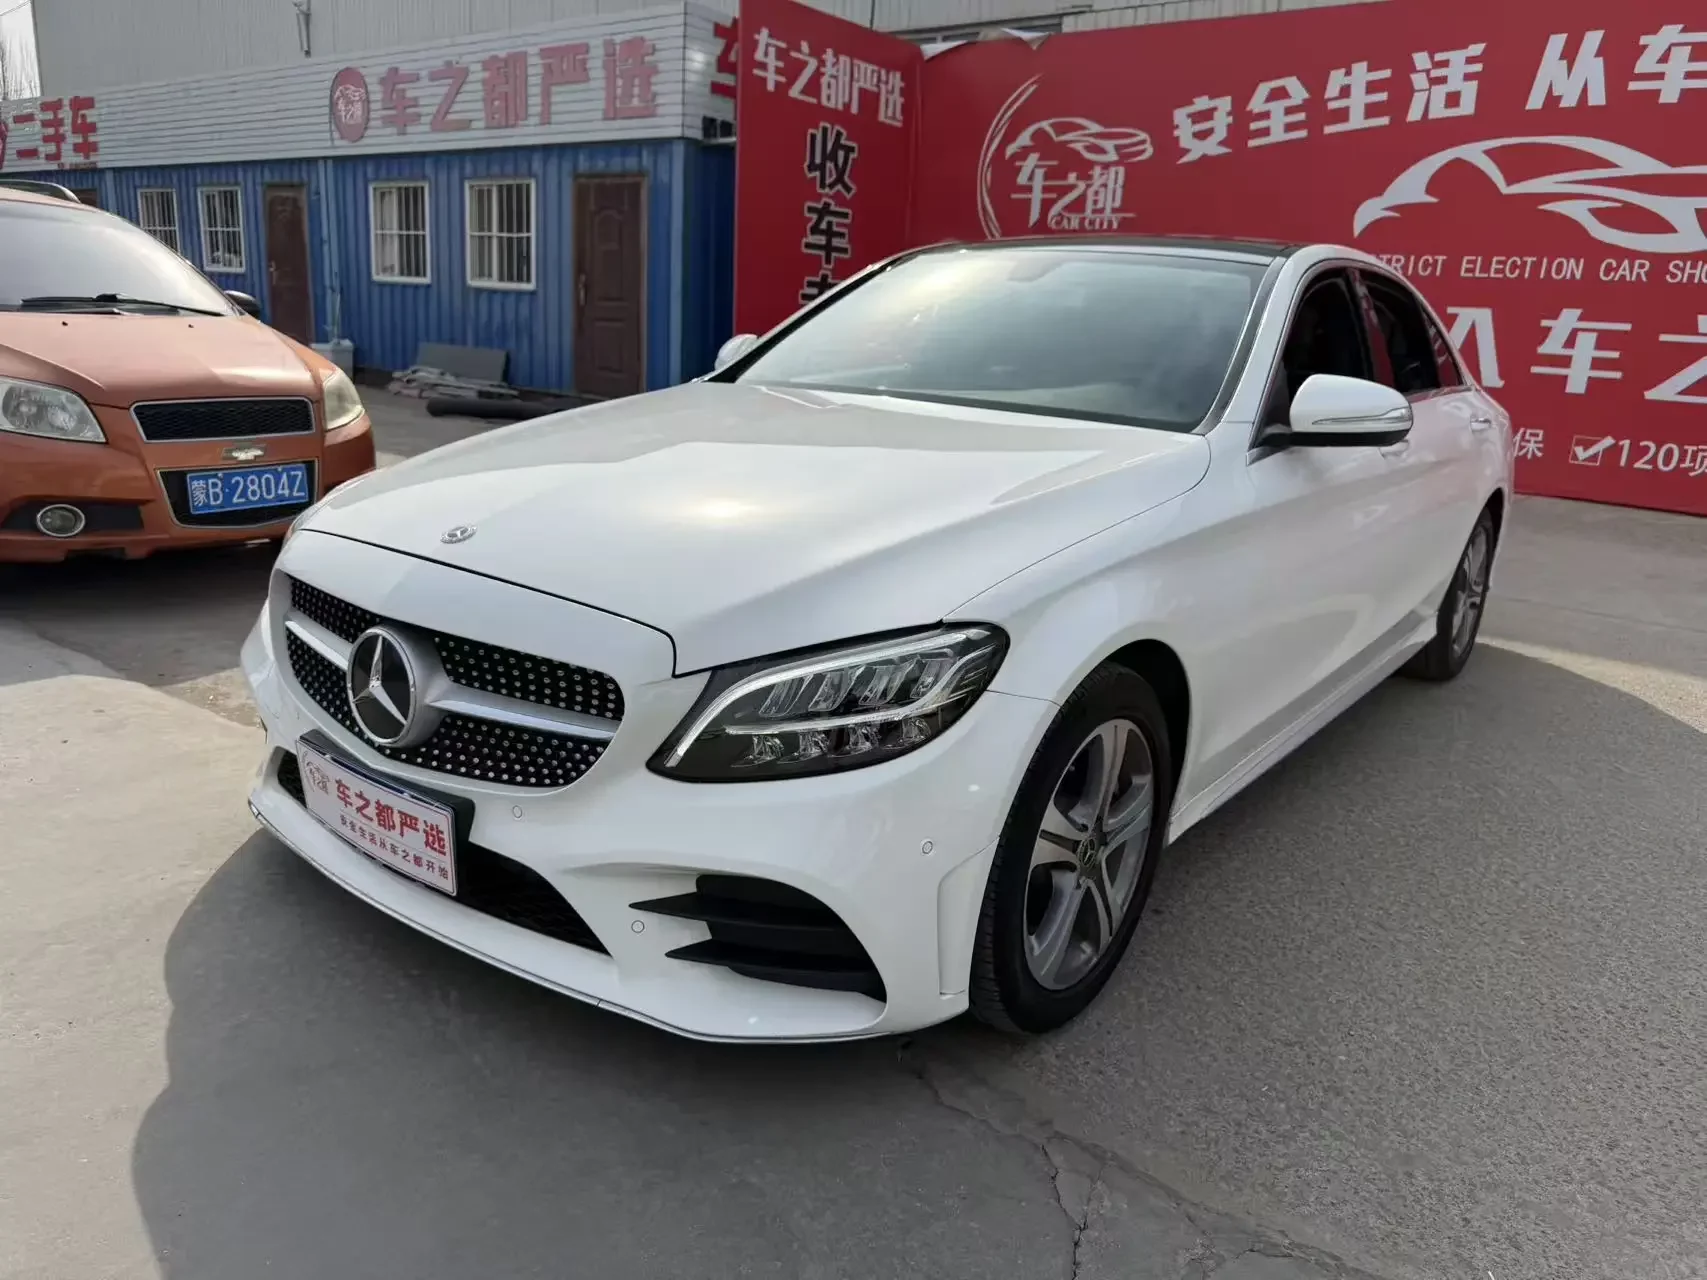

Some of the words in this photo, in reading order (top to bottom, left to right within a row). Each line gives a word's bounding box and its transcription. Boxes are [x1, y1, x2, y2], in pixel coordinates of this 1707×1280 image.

[379, 36, 659, 135] 车之都严选
[752, 26, 906, 127] 车之都严选
[1173, 42, 1487, 164] 安全生活
[1525, 24, 1707, 111] 从车
[13, 95, 98, 161] 二手车
[1010, 152, 1136, 229] 车之都
[1460, 255, 1584, 280] ELECTION
[1599, 258, 1651, 282] CAR
[335, 778, 447, 857] 车之都严选
